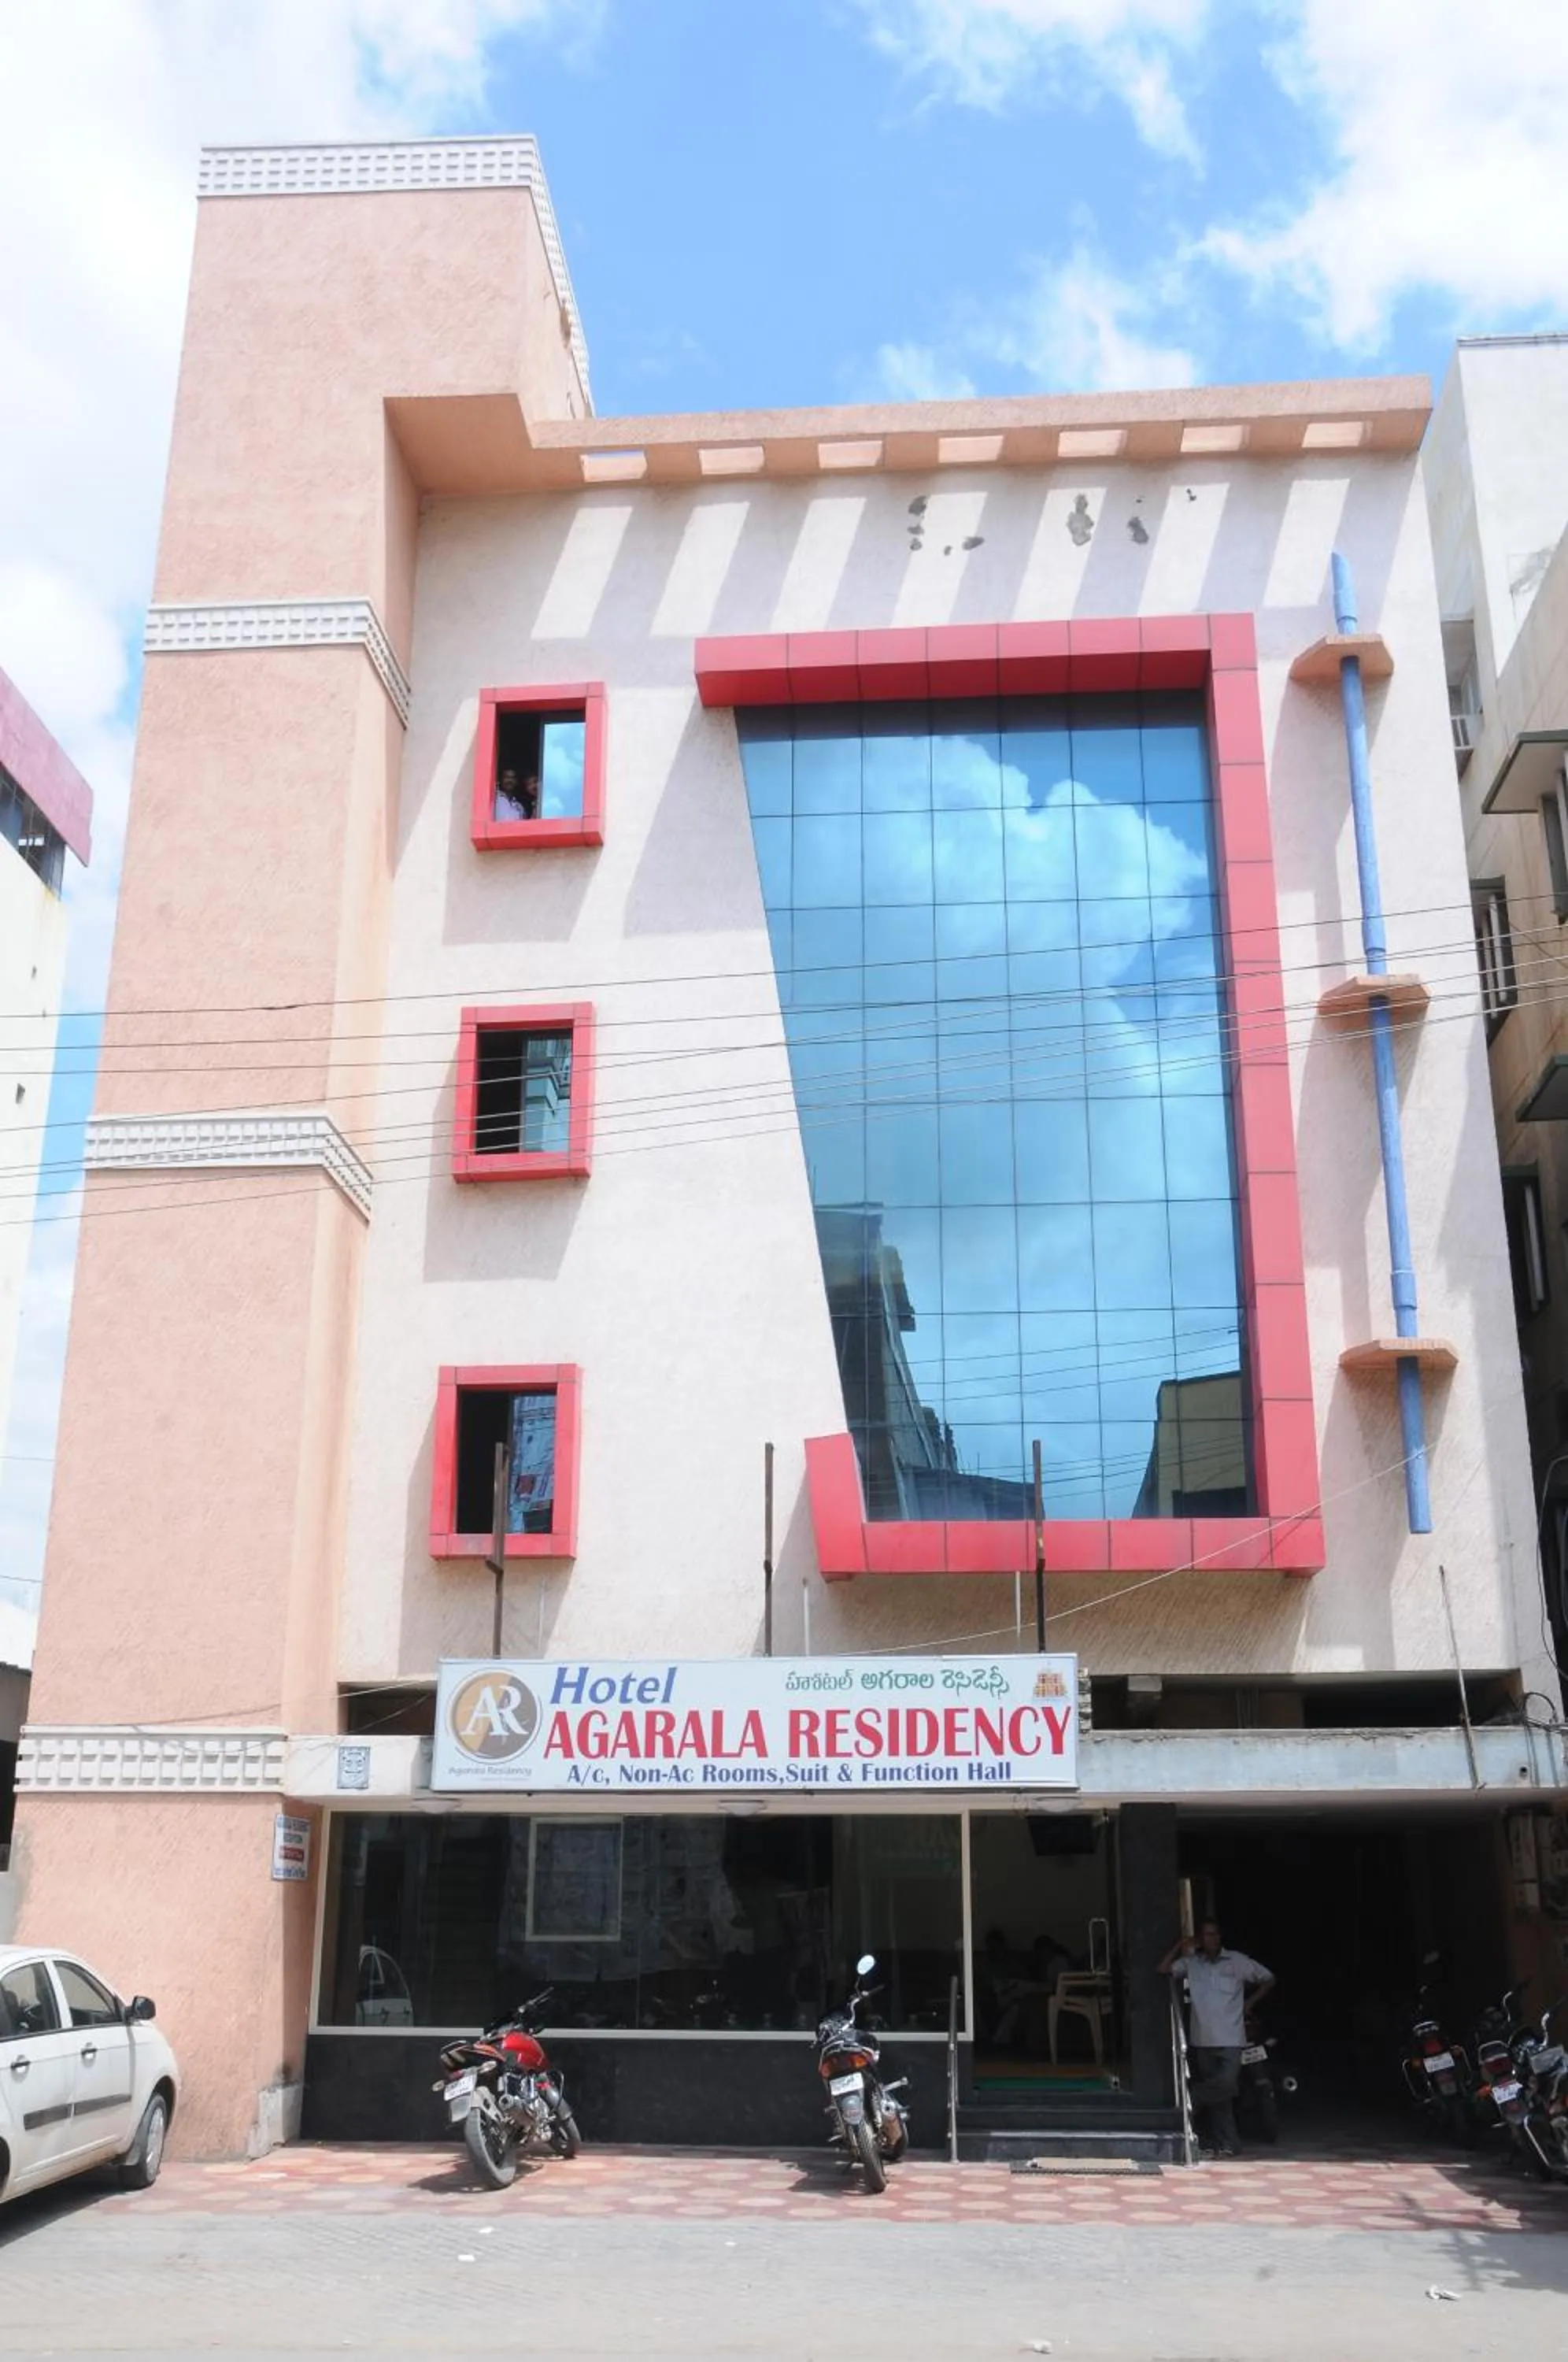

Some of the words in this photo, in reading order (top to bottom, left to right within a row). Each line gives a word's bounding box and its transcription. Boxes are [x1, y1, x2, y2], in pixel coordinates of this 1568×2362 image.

[549, 1667, 677, 1705] Hotel
[861, 1669, 934, 1690] అగరాల
[460, 1685, 530, 1735] AR
[543, 1709, 768, 1759] AGARALA
[789, 1706, 1071, 1758] RESIDENCY
[619, 1764, 693, 1783] Non-Ac
[838, 1763, 852, 1782] &
[862, 1763, 958, 1782] Function
[968, 1761, 1011, 1780] Hall
